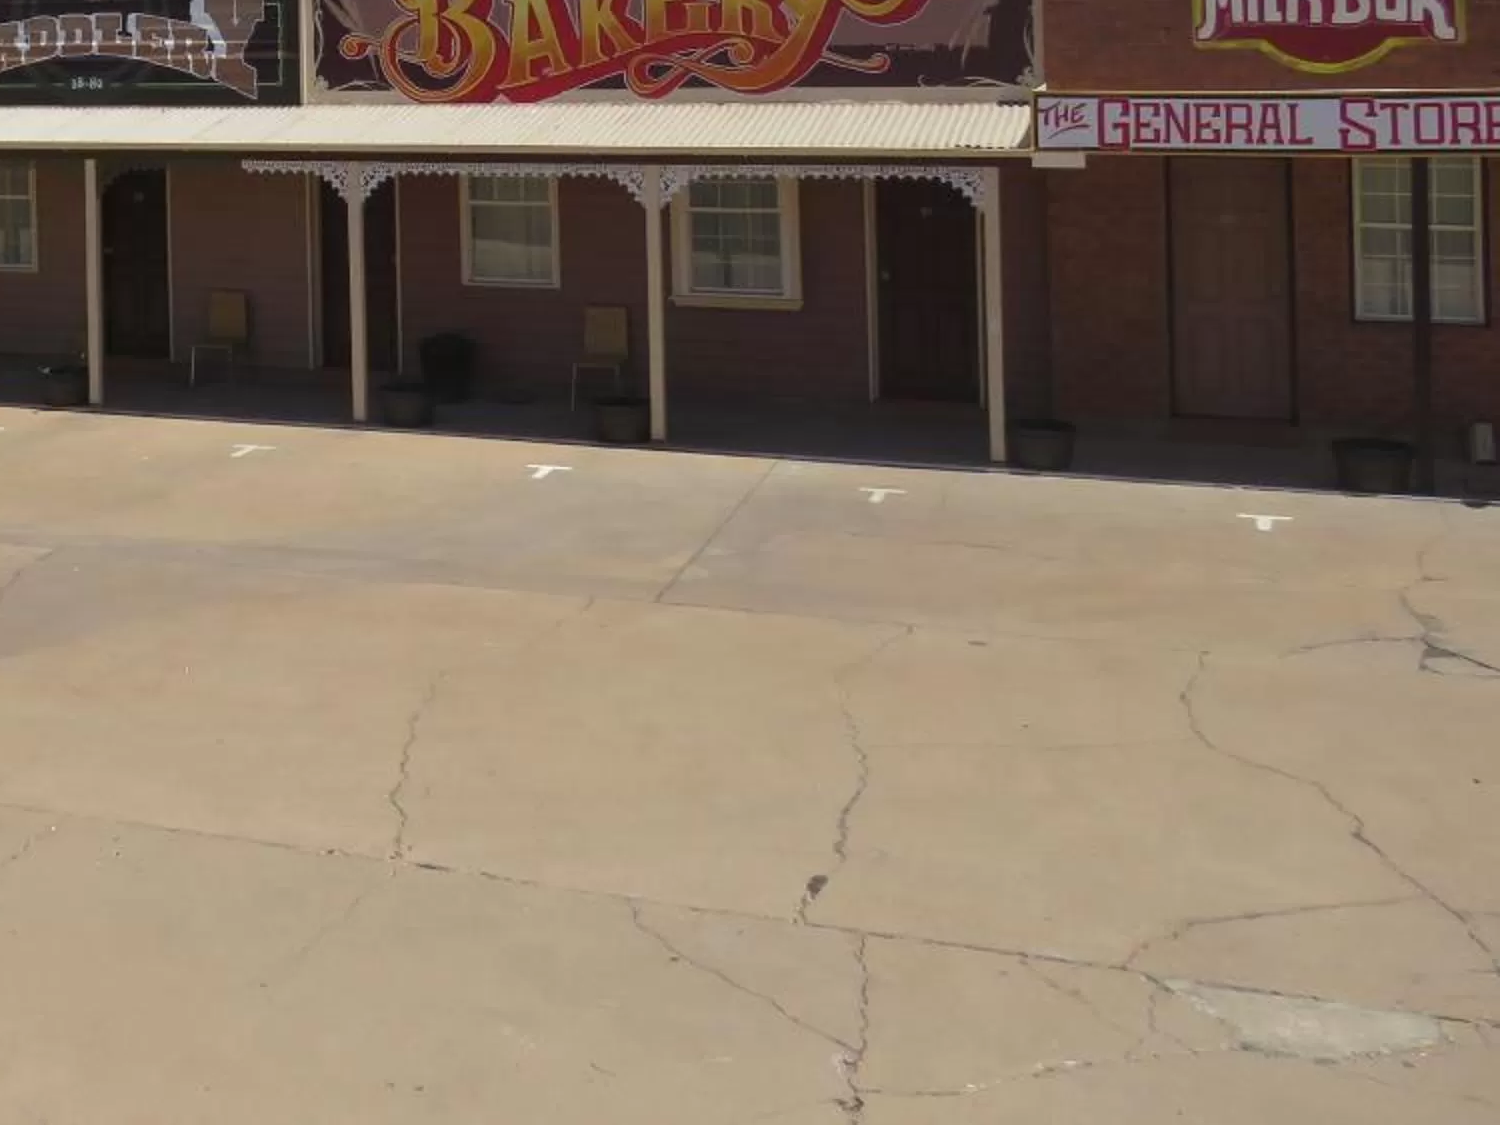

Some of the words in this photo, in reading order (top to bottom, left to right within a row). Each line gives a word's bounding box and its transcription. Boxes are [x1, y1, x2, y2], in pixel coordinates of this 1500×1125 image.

[1037, 101, 1088, 128] THE
[1098, 98, 1314, 151] GENERAL
[1338, 97, 1500, 152] STORE
